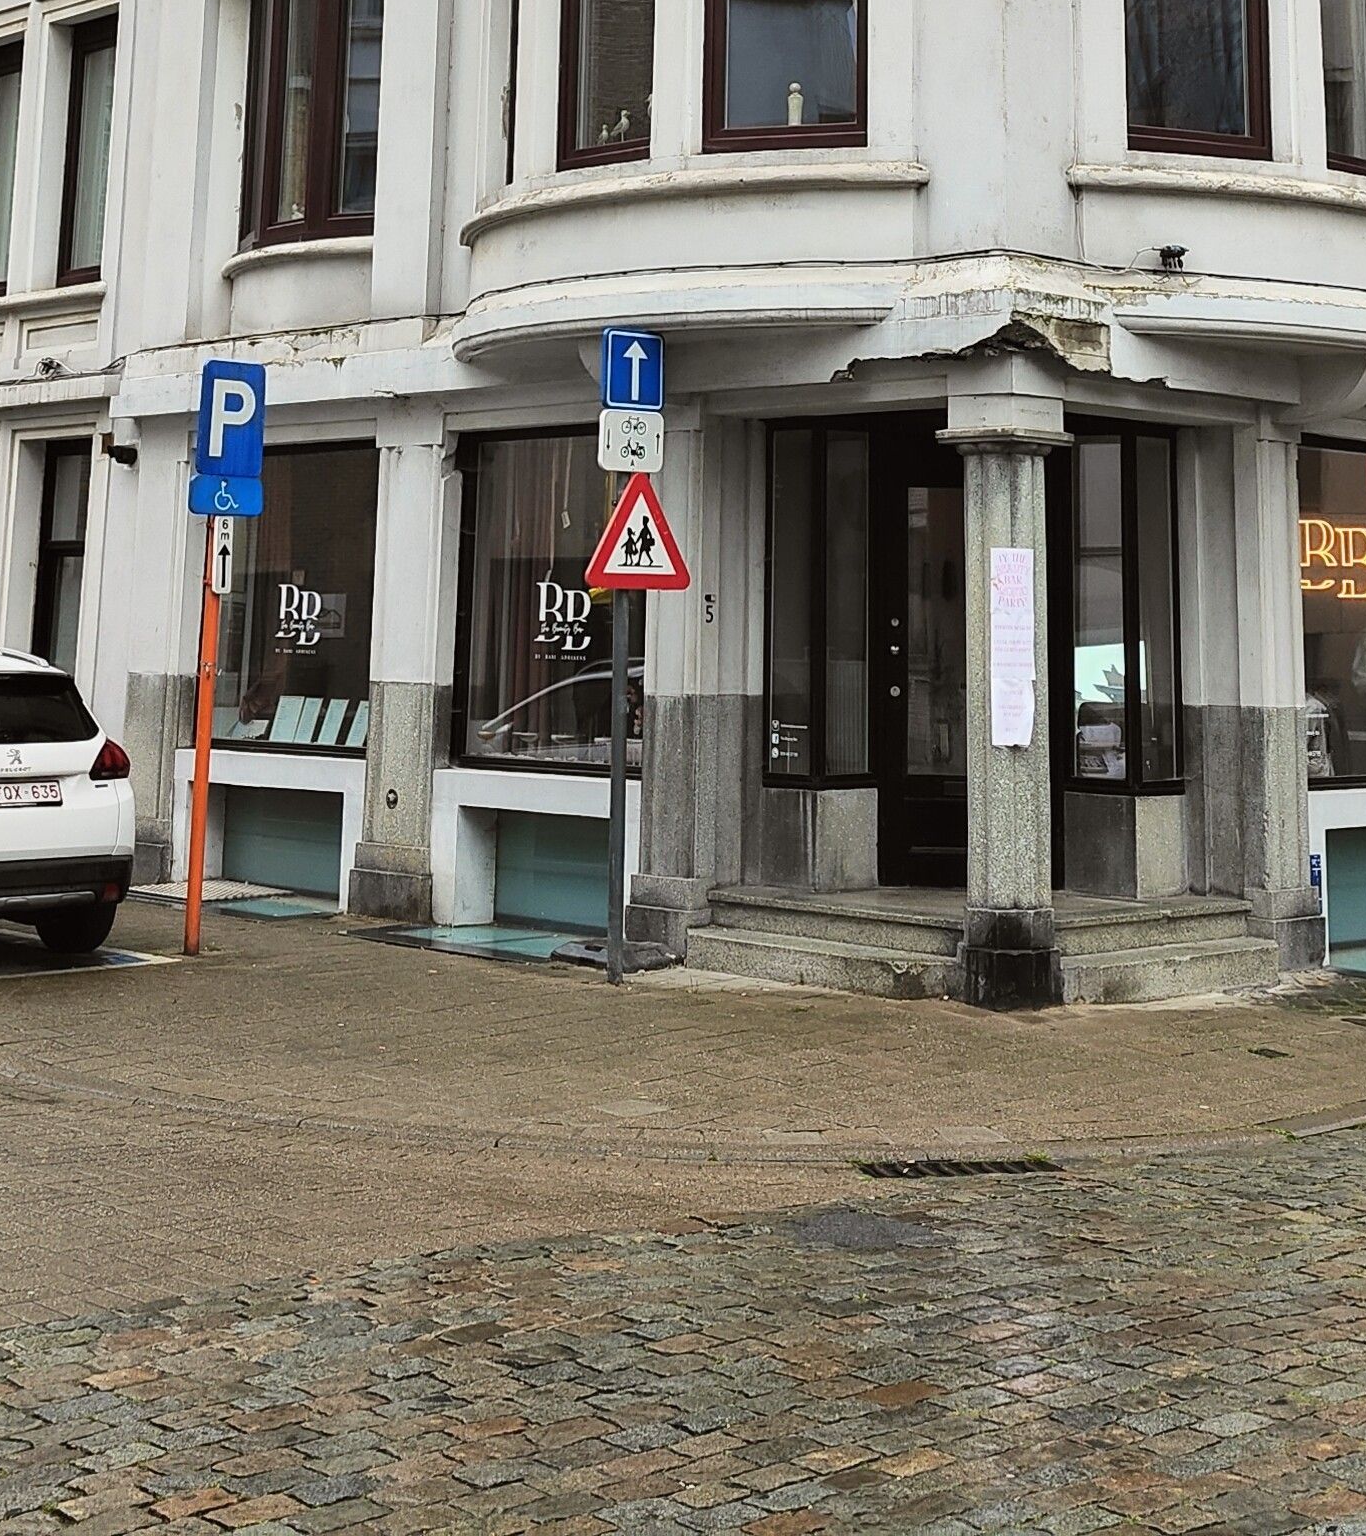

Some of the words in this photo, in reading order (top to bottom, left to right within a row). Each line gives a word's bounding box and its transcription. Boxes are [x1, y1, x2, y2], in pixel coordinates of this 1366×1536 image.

[209, 378, 256, 457] P
[222, 519, 229, 529] 6
[705, 604, 714, 623] 5
